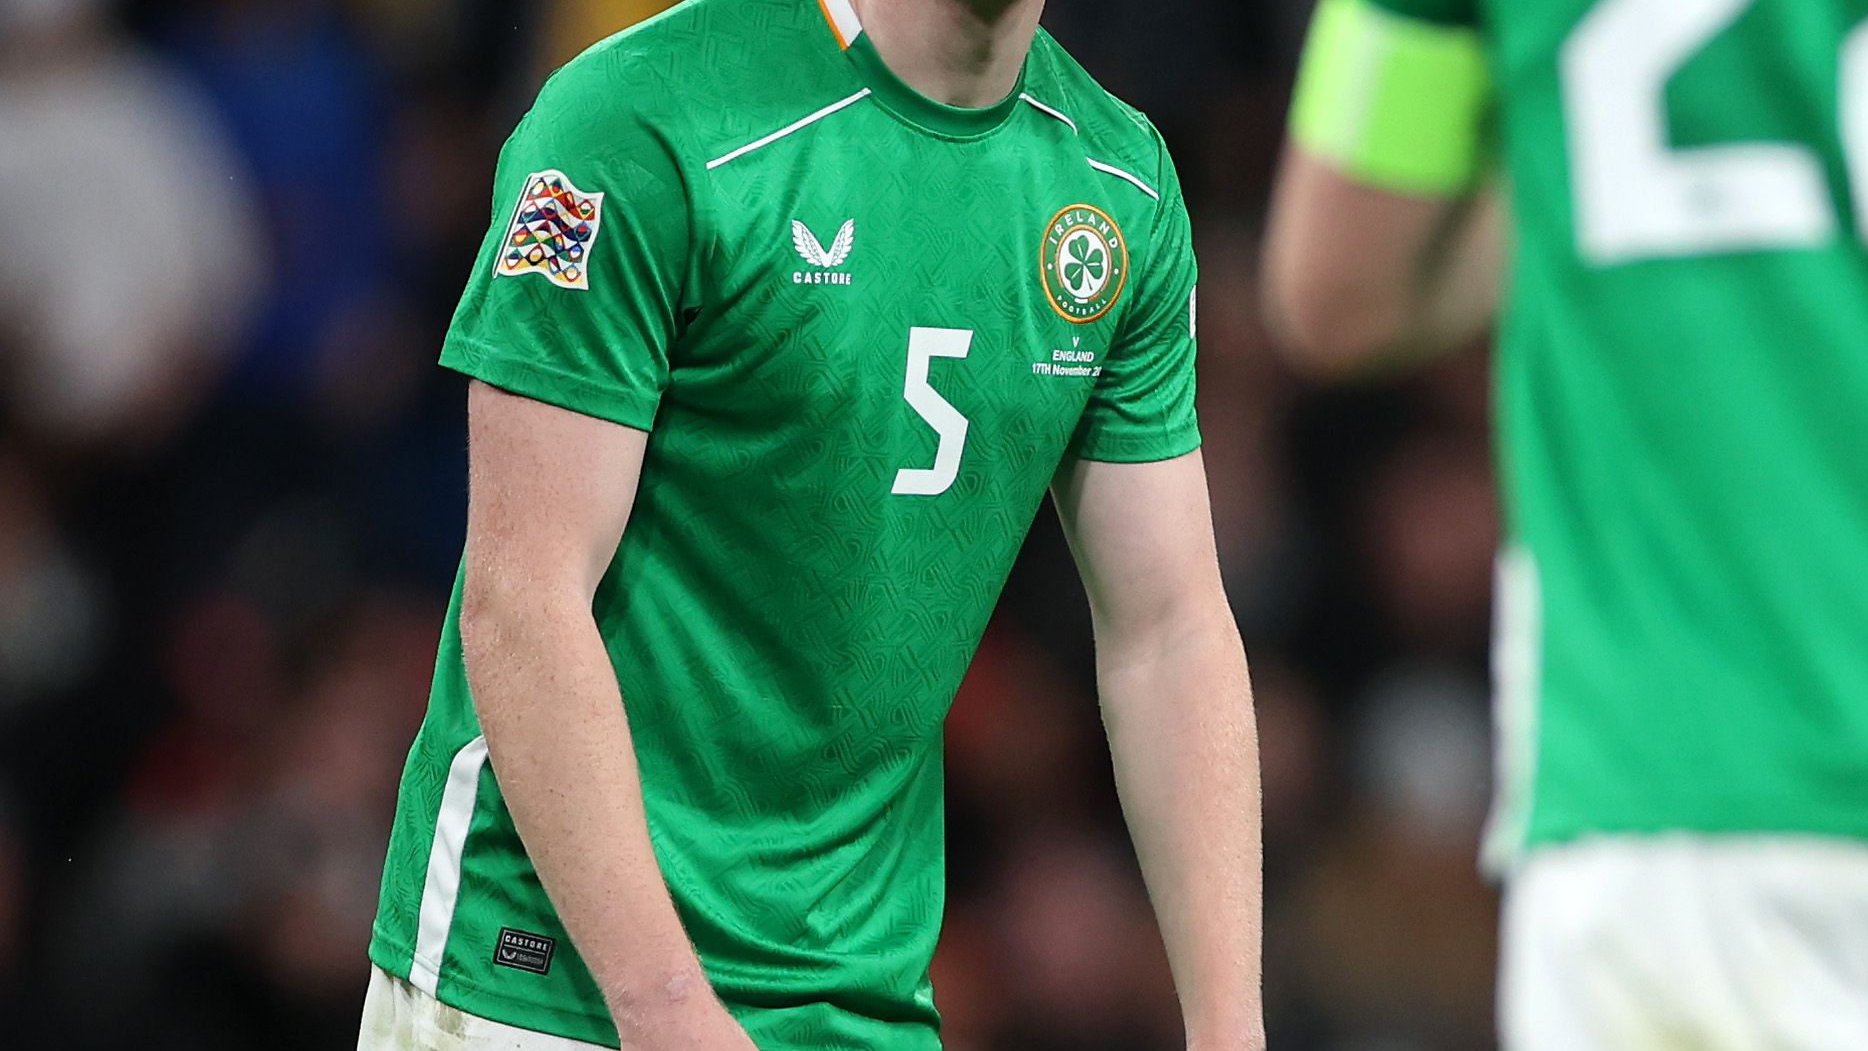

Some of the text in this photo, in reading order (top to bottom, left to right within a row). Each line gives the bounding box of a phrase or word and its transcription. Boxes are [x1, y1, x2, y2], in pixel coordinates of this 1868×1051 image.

[1049, 211, 1118, 248] IRELAND
[793, 271, 852, 286] CASTORE
[1057, 295, 1107, 315] FOOTBALL
[1052, 349, 1095, 362] ENGLAND
[1032, 362, 1052, 375] 17TH
[1052, 364, 1092, 376] November
[890, 325, 975, 496] 5
[505, 935, 548, 951] CASTORE
